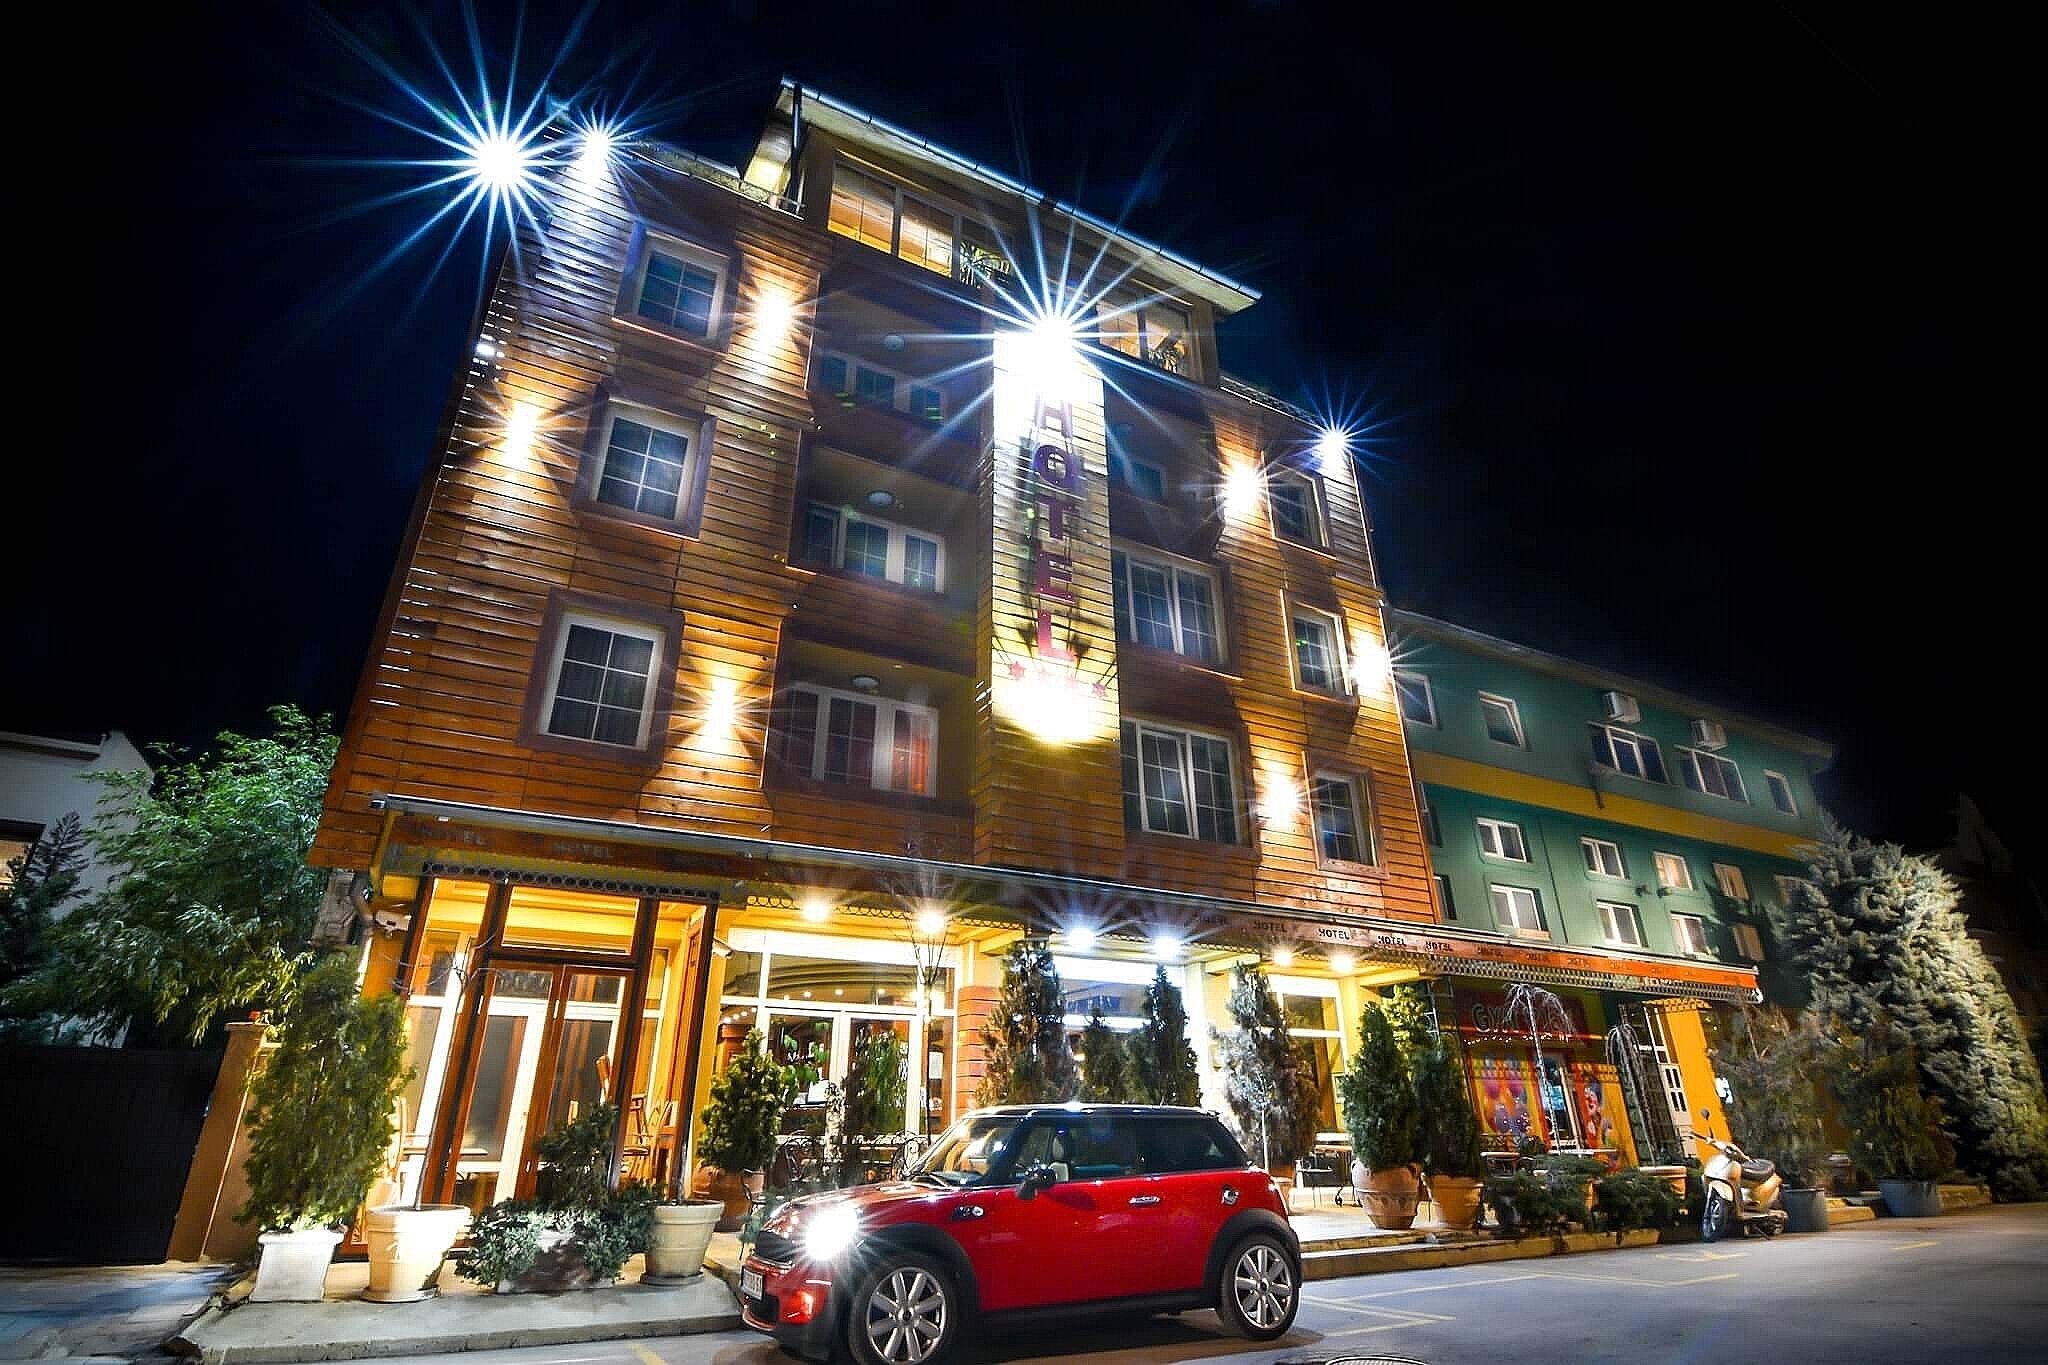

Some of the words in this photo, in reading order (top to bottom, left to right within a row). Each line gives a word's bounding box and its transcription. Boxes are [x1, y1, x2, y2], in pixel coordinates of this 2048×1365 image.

[1318, 927, 1350, 941] HOTEL
[1377, 935, 1408, 948] HOTEL
[1424, 940, 1454, 952] HOTEL
